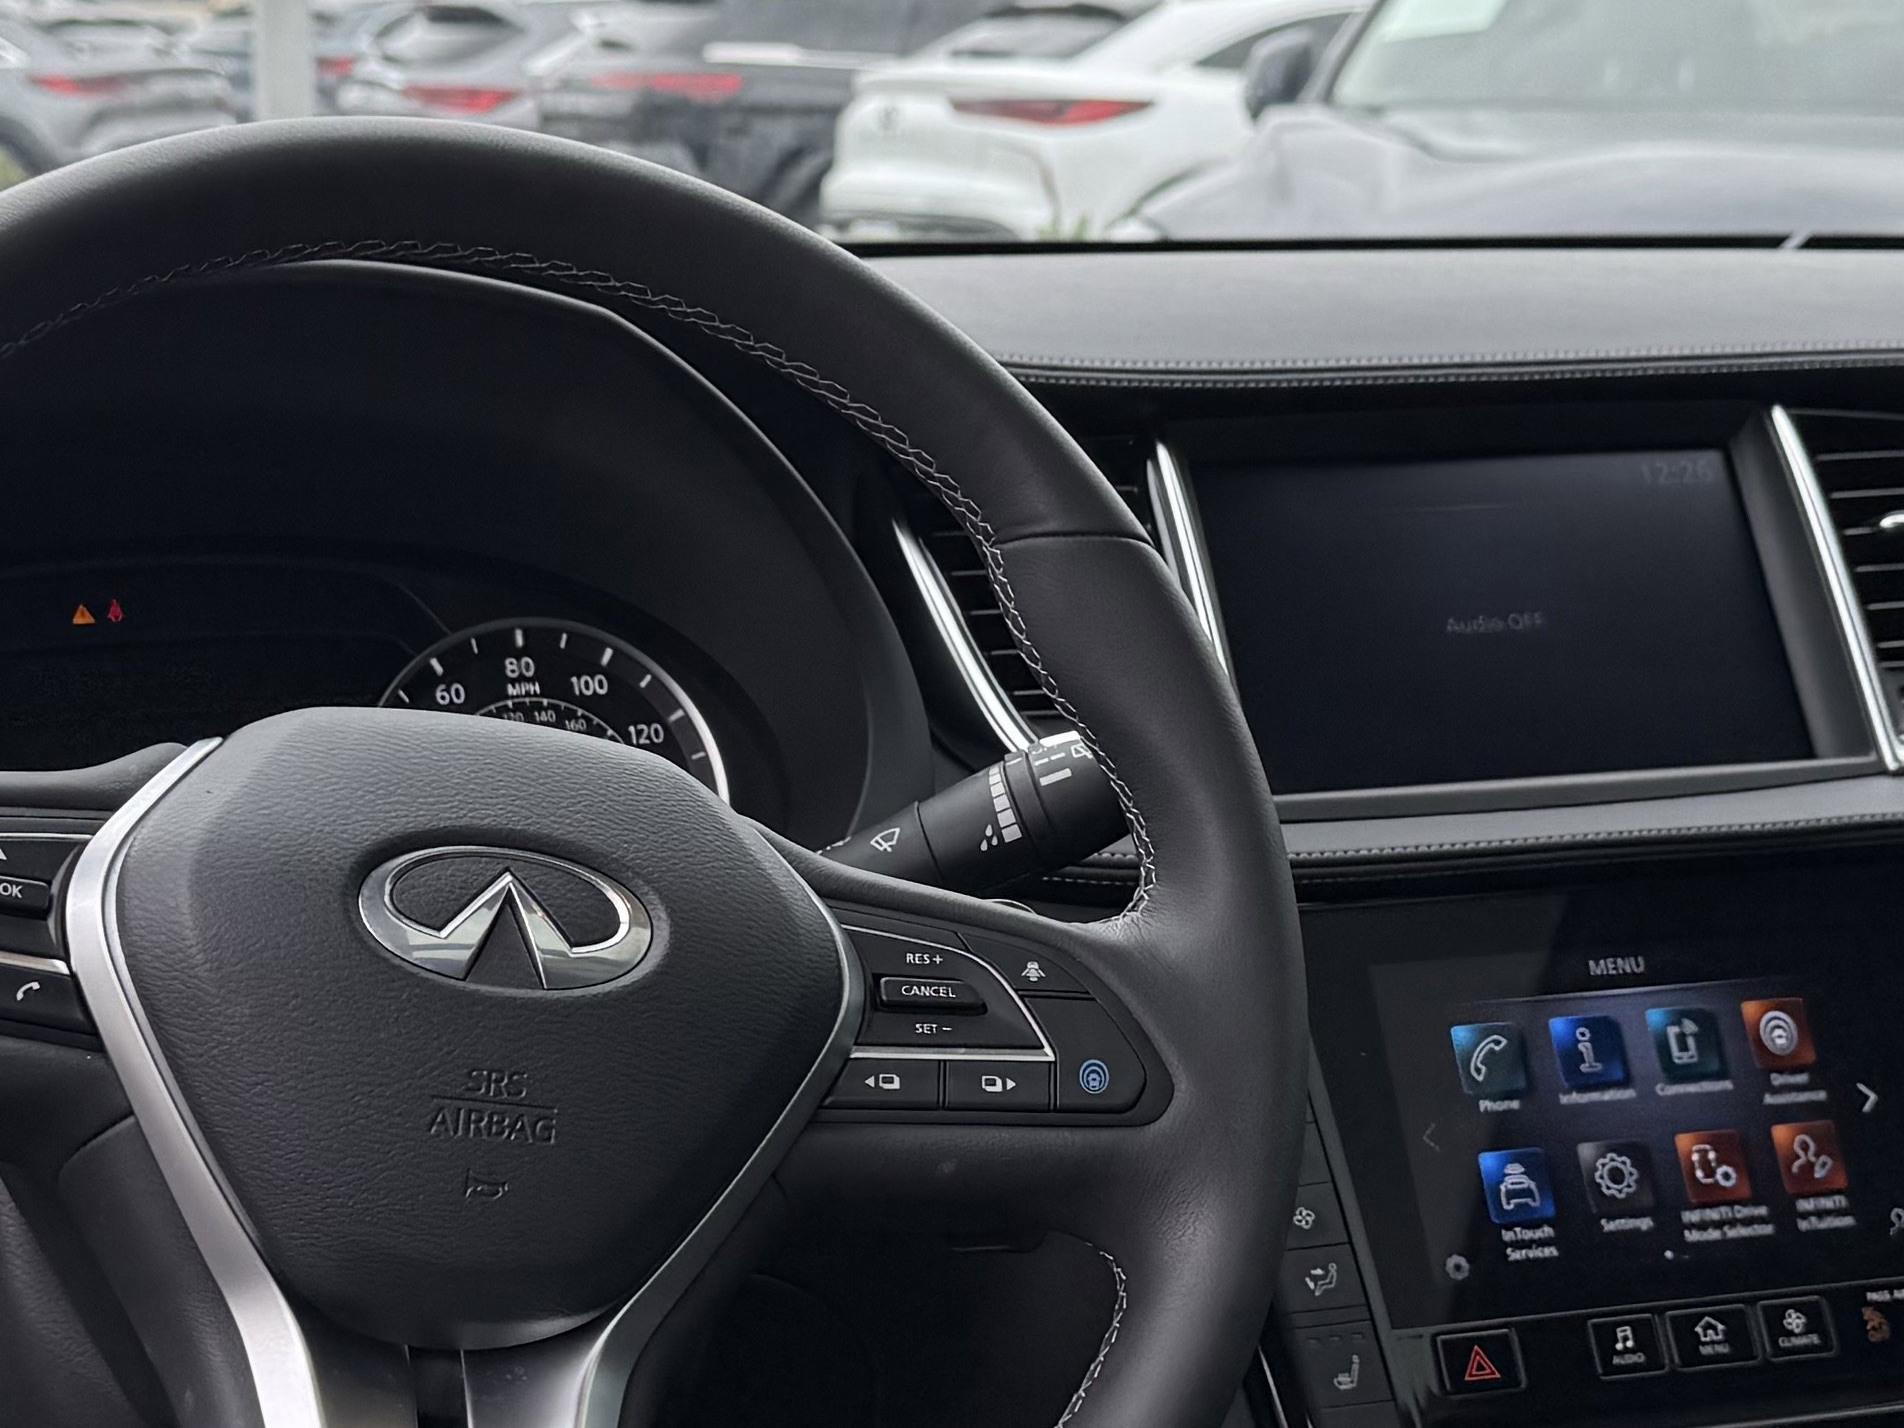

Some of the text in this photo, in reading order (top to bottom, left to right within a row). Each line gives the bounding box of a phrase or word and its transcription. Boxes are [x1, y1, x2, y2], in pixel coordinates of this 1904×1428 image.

[505, 657, 535, 678] 80
[507, 682, 540, 696] MPH
[571, 674, 608, 696] 100
[436, 683, 465, 705] 60
[534, 710, 556, 724] 140
[565, 718, 587, 732] 160
[629, 723, 664, 745] 120
[1588, 956, 1645, 977] MENU
[901, 984, 956, 999] CANCEL
[461, 1070, 528, 1099] SRS
[1479, 1098, 1520, 1113] Phone
[428, 1106, 556, 1145] AIRBAG
[1600, 1216, 1654, 1233] Settings
[1501, 1225, 1555, 1242] InTouch
[1506, 1245, 1559, 1262] Services
[1699, 1343, 1730, 1356] MENU
[1778, 1333, 1822, 1349] CLIMATE
[1612, 1353, 1645, 1366] AUDIO
